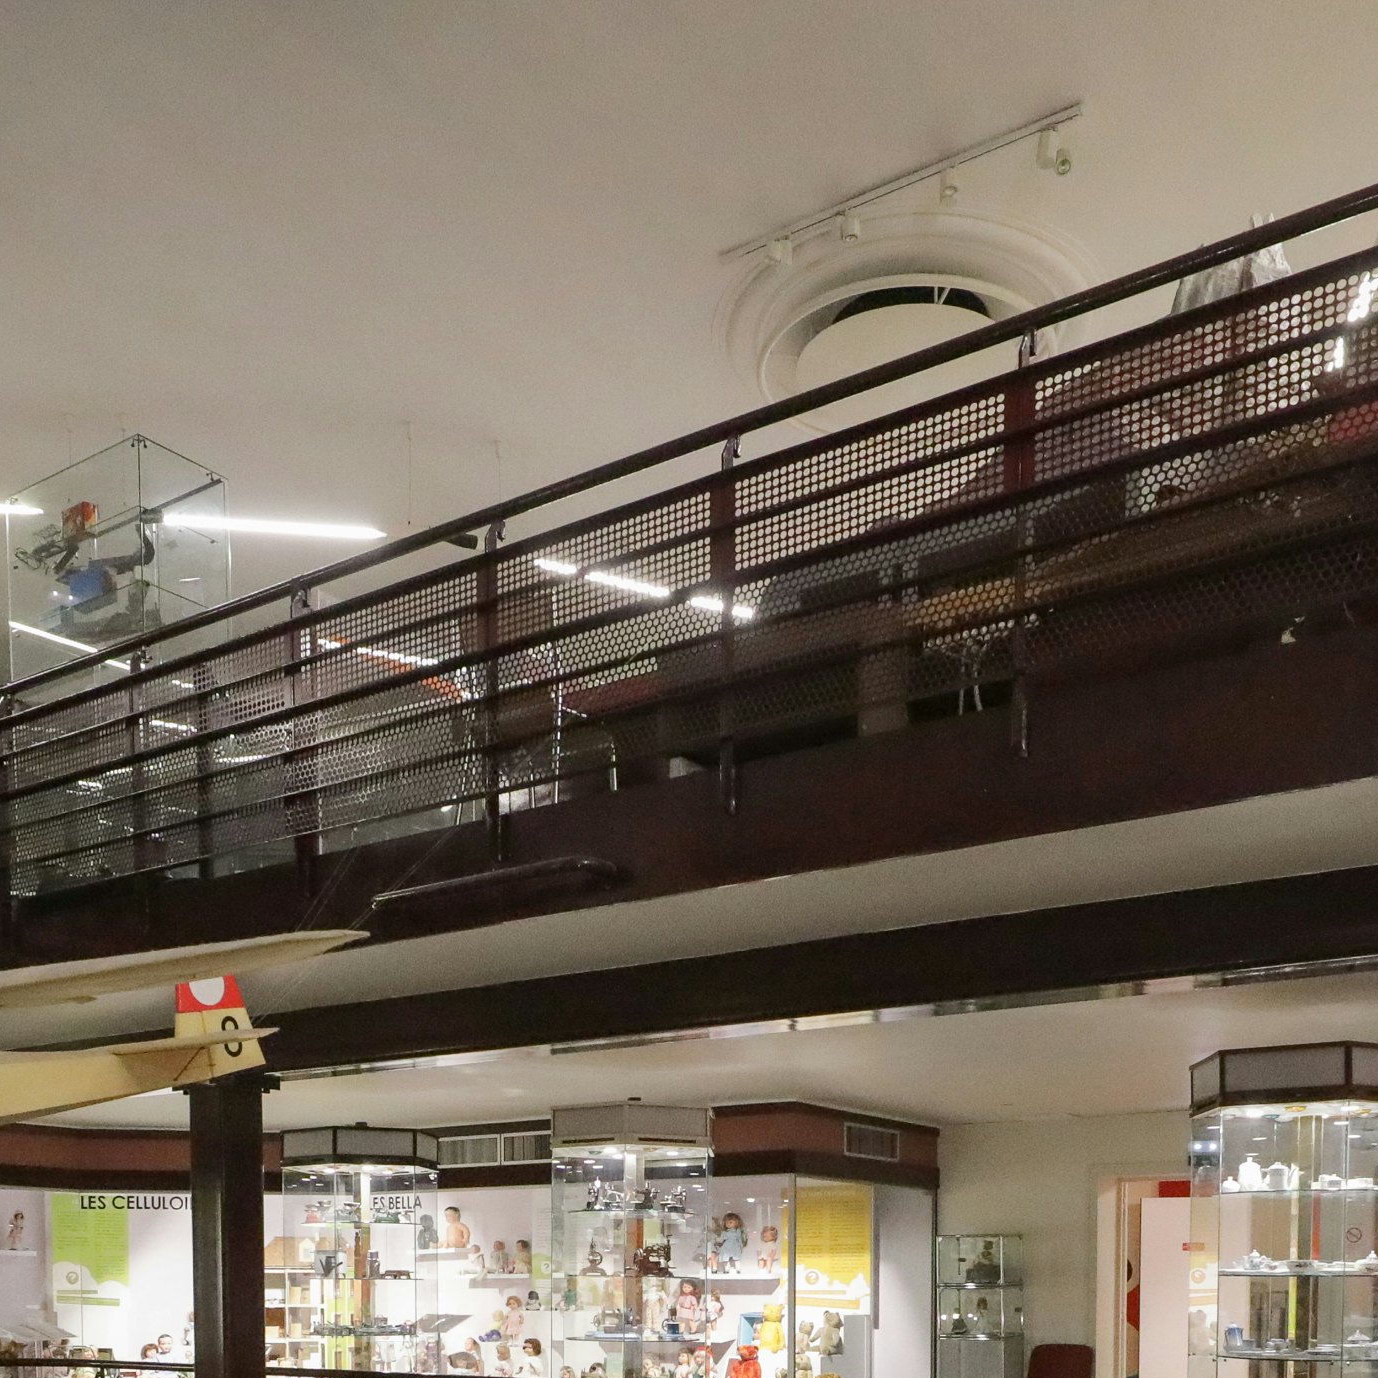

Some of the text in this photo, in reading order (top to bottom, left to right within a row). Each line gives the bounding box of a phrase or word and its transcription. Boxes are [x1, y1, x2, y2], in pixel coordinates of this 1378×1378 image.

[80, 1195, 192, 1211] LES CELLULOI
[388, 1195, 423, 1210] BELLA
